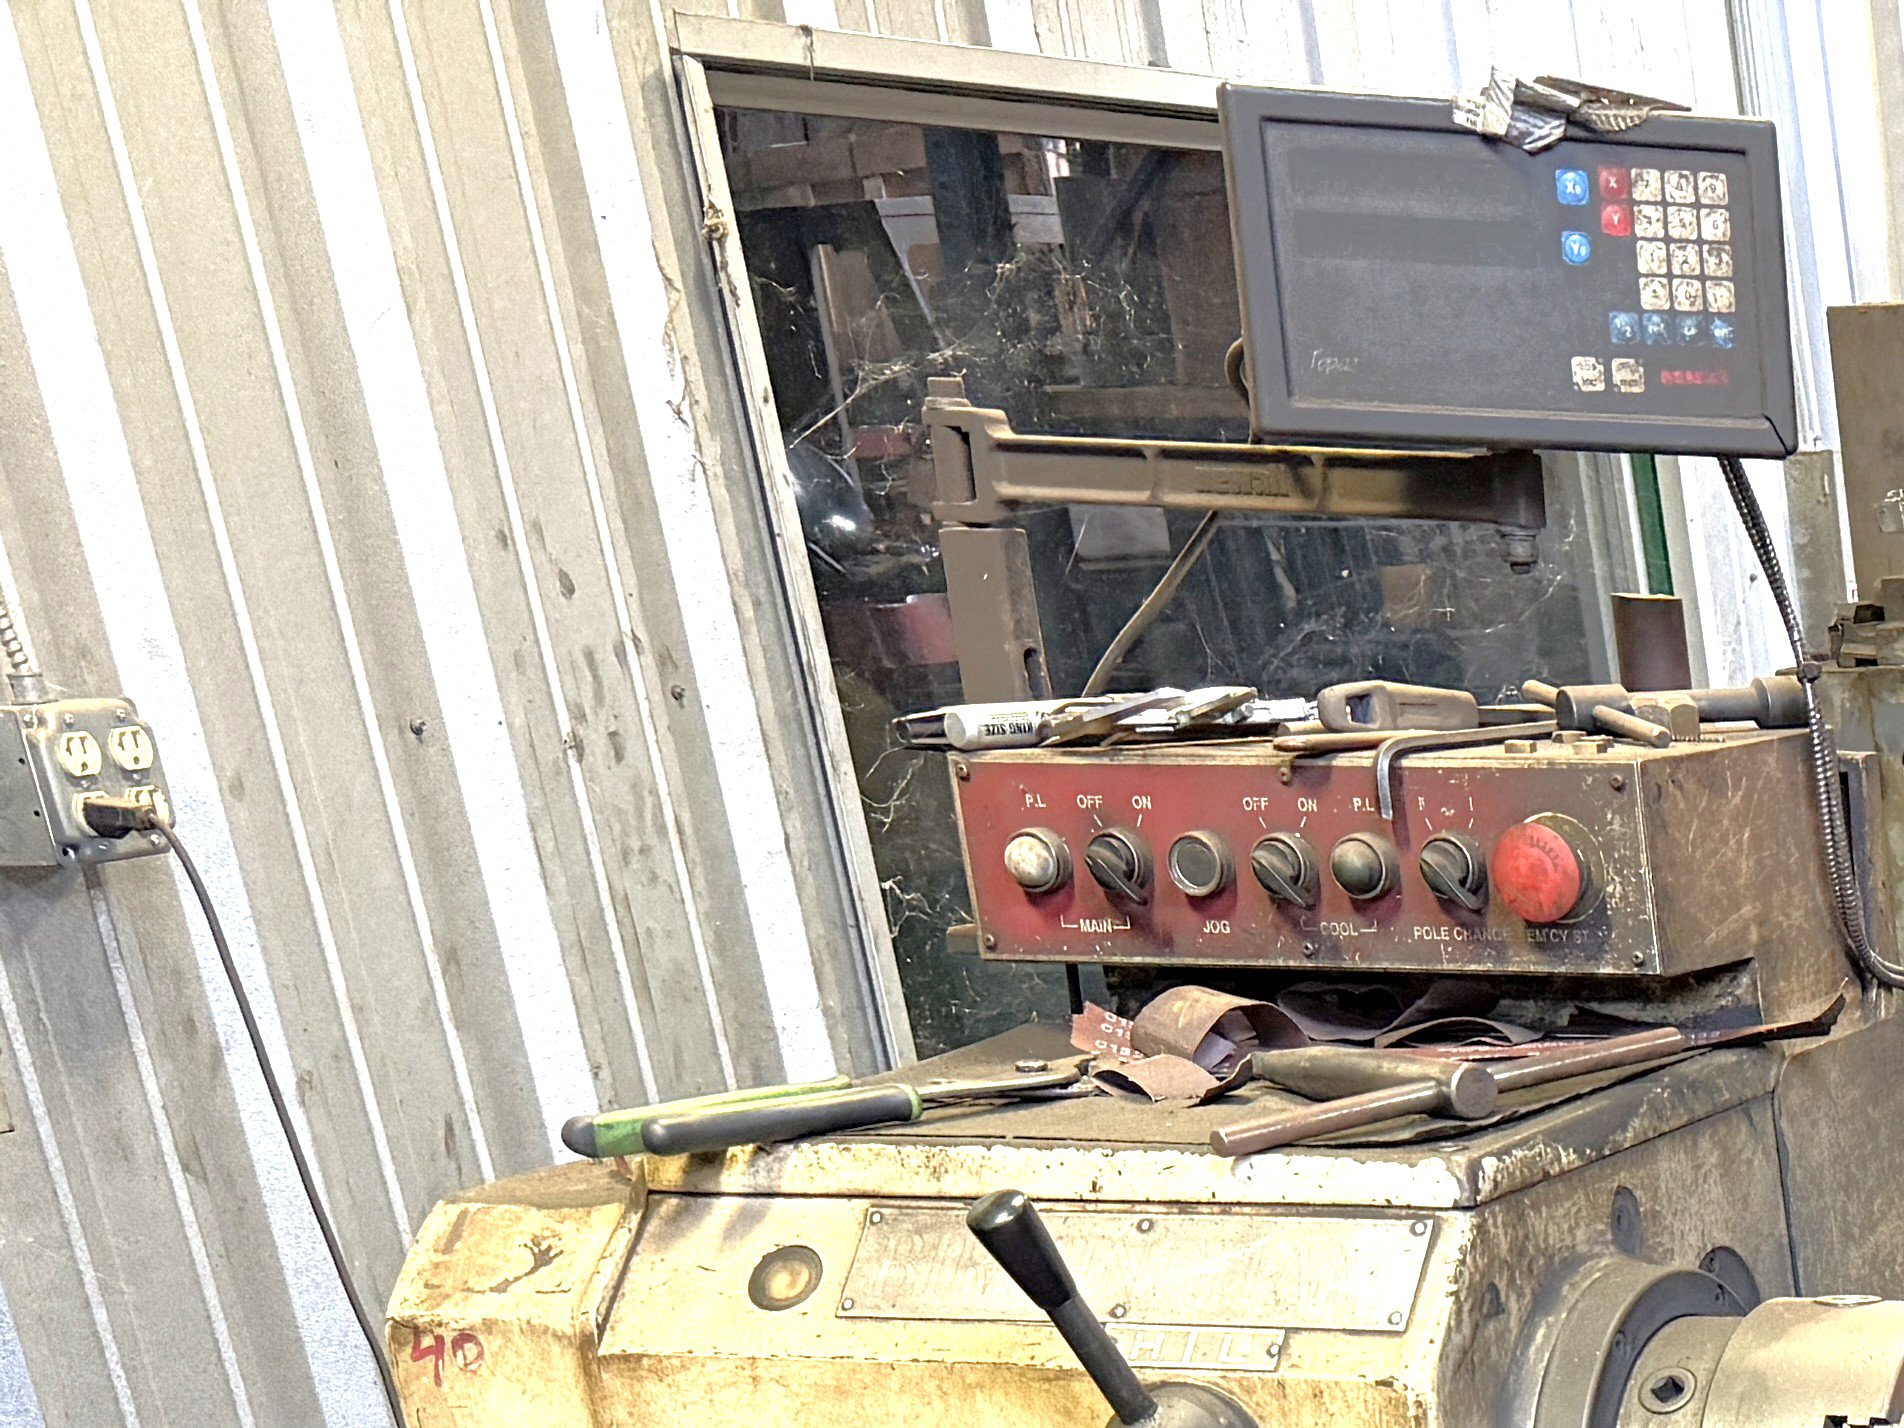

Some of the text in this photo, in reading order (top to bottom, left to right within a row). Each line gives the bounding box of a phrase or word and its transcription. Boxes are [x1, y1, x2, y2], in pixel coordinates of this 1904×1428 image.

[1608, 177, 1617, 188] X
[1611, 212, 1620, 224] Y
[1712, 220, 1719, 229] 6
[984, 721, 1034, 736] KING SIZE
[1077, 795, 1152, 809] OFF ON
[1243, 796, 1317, 812] OFF ON
[1079, 919, 1112, 933] MAIN
[1203, 920, 1231, 934] JOG
[1319, 921, 1358, 937] COOL
[1414, 926, 1512, 942] POLE CHANGE
[1132, 1331, 1249, 1363] H L
[411, 1328, 485, 1387] 40
